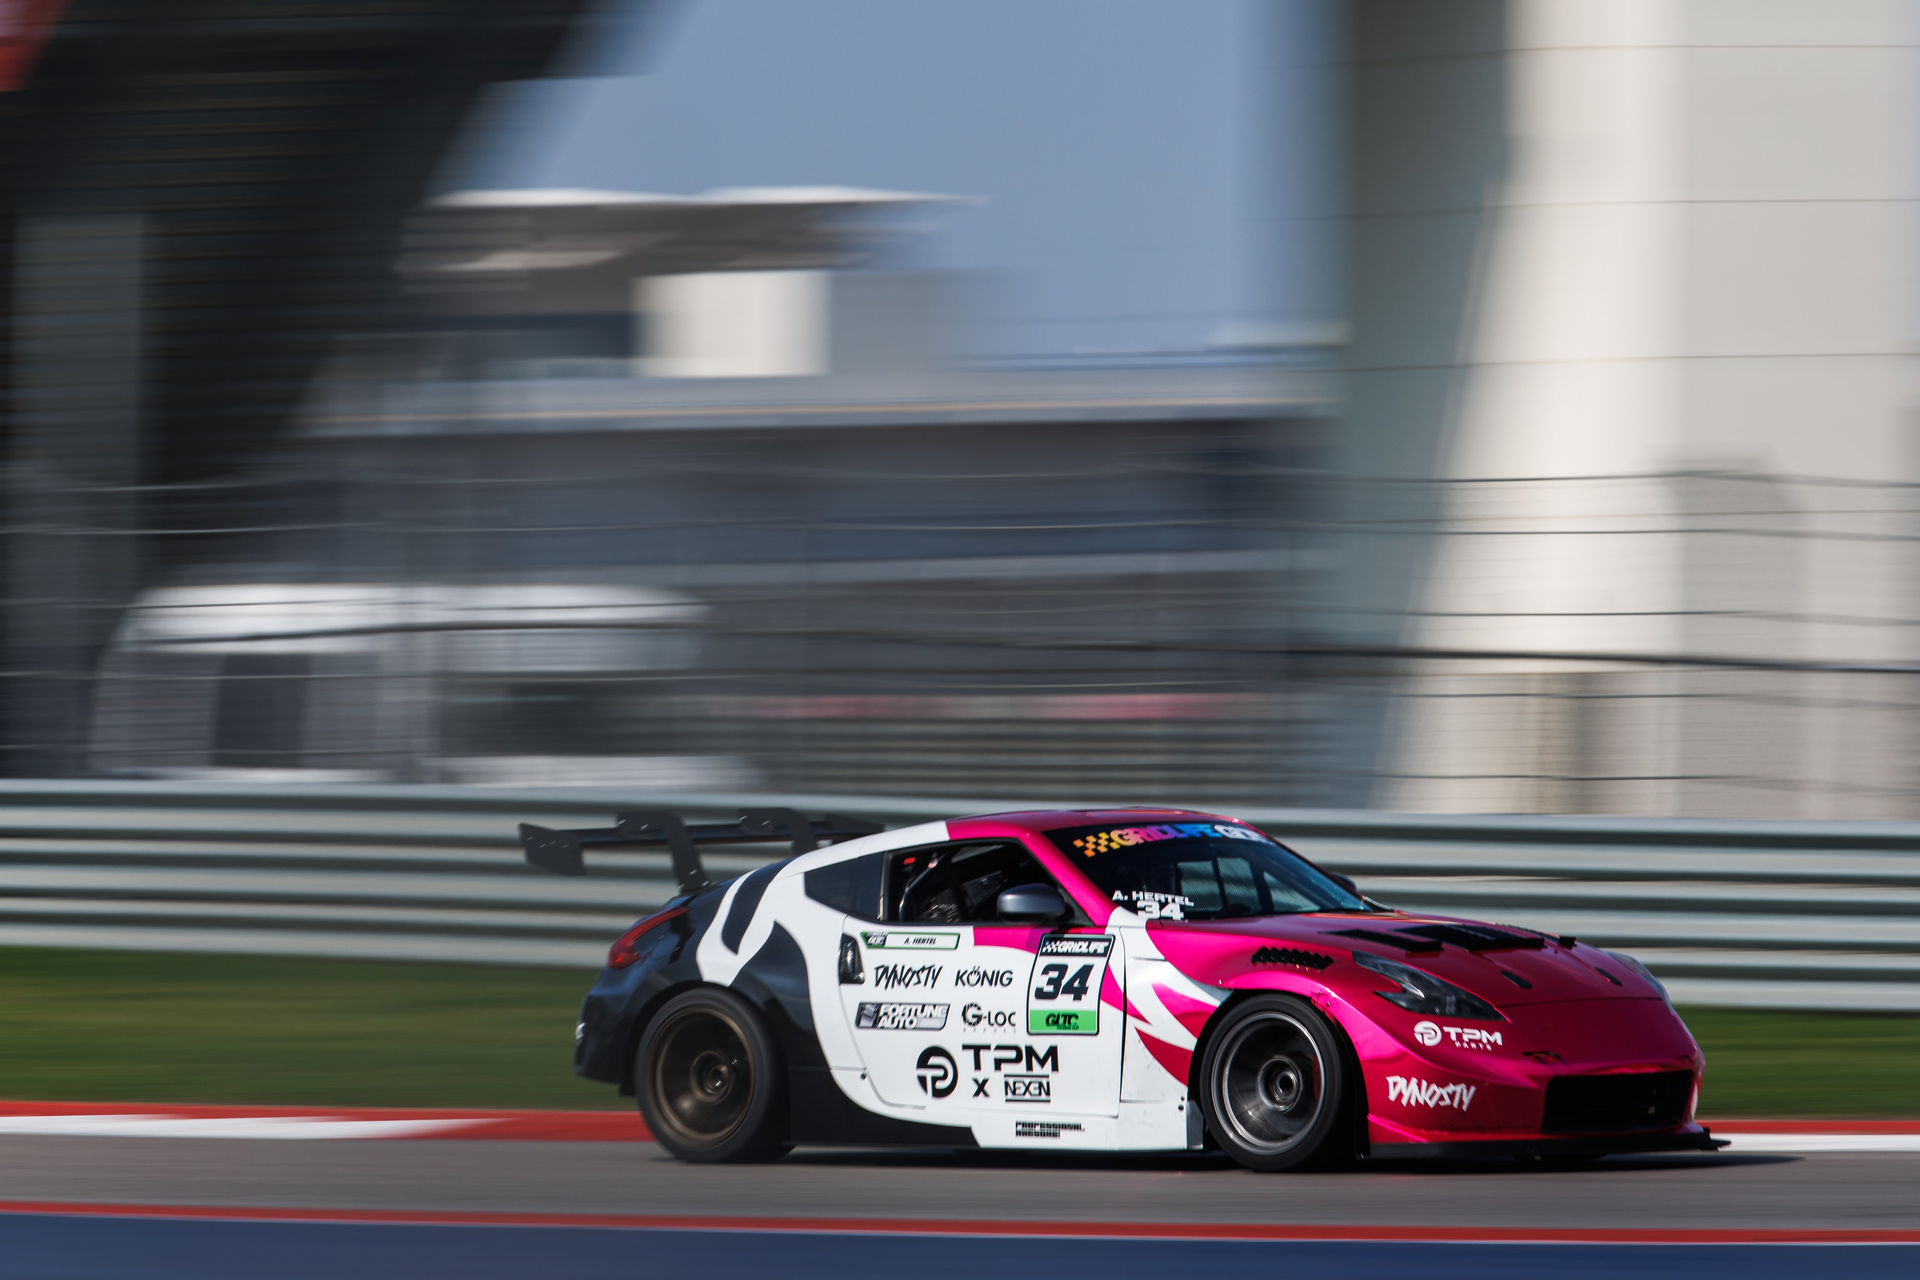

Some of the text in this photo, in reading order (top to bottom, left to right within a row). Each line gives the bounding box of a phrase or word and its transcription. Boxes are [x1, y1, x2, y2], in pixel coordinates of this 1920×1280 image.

[1110, 824, 1223, 846] GRIDLIFE
[1112, 890, 1195, 907] A. HERTEL
[1137, 900, 1184, 921] 34
[1058, 941, 1109, 953] GRIDLIFE
[874, 964, 944, 990] DYNOSTY
[955, 966, 1013, 987] KÖNIG
[1034, 964, 1094, 1001] 34
[880, 1004, 947, 1017] FORTUNE
[962, 1002, 1017, 1027] G-LOC
[878, 1016, 918, 1029] AUTO
[1442, 1026, 1503, 1046] TPM
[1455, 1040, 1492, 1051] PARTS
[962, 1043, 1059, 1072] TPM
[1004, 1080, 1051, 1097] NEXEN
[1385, 1074, 1477, 1113] DYNOSTY
